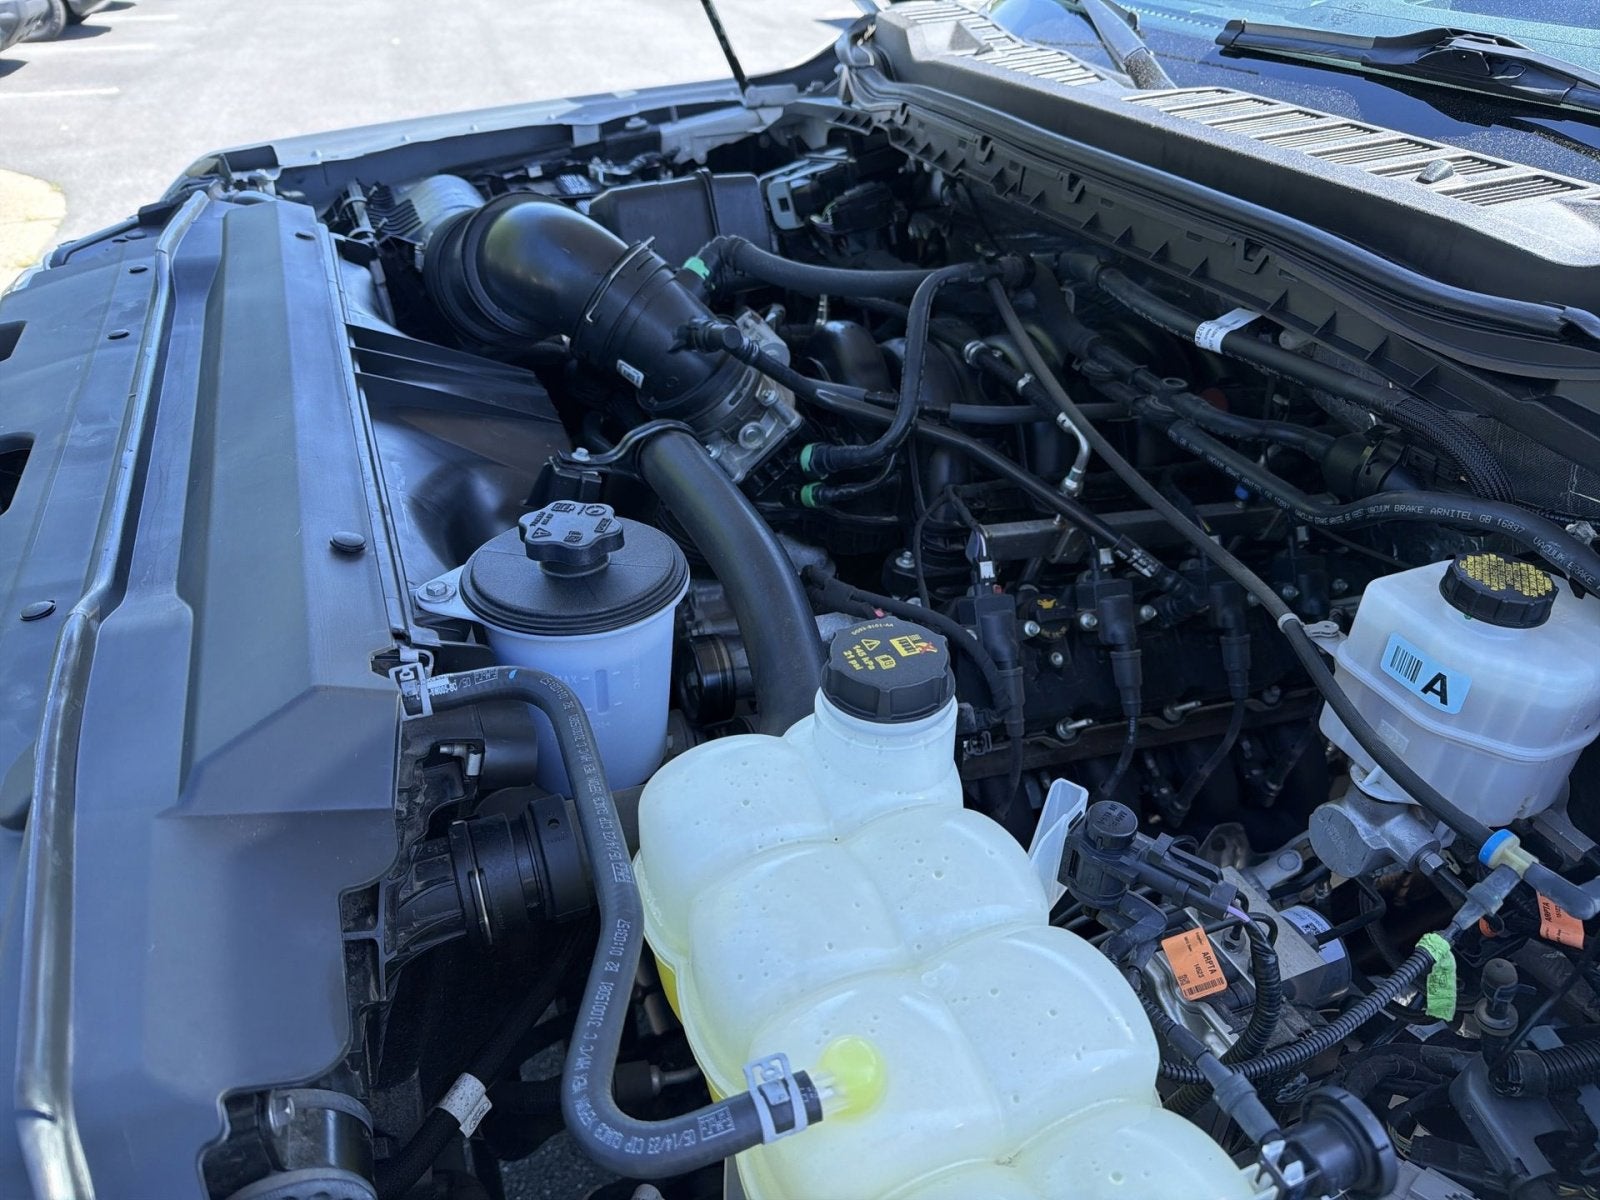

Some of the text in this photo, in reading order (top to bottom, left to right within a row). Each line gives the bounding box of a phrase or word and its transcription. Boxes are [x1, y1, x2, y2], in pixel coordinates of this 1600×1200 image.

[1393, 503, 1425, 515] BRAKE
[1429, 506, 1474, 521] ARNITEL
[1479, 513, 1493, 524] GB
[1420, 671, 1449, 706] A
[609, 918, 632, 957] 01:03:57
[1202, 951, 1217, 974] ARPTA
